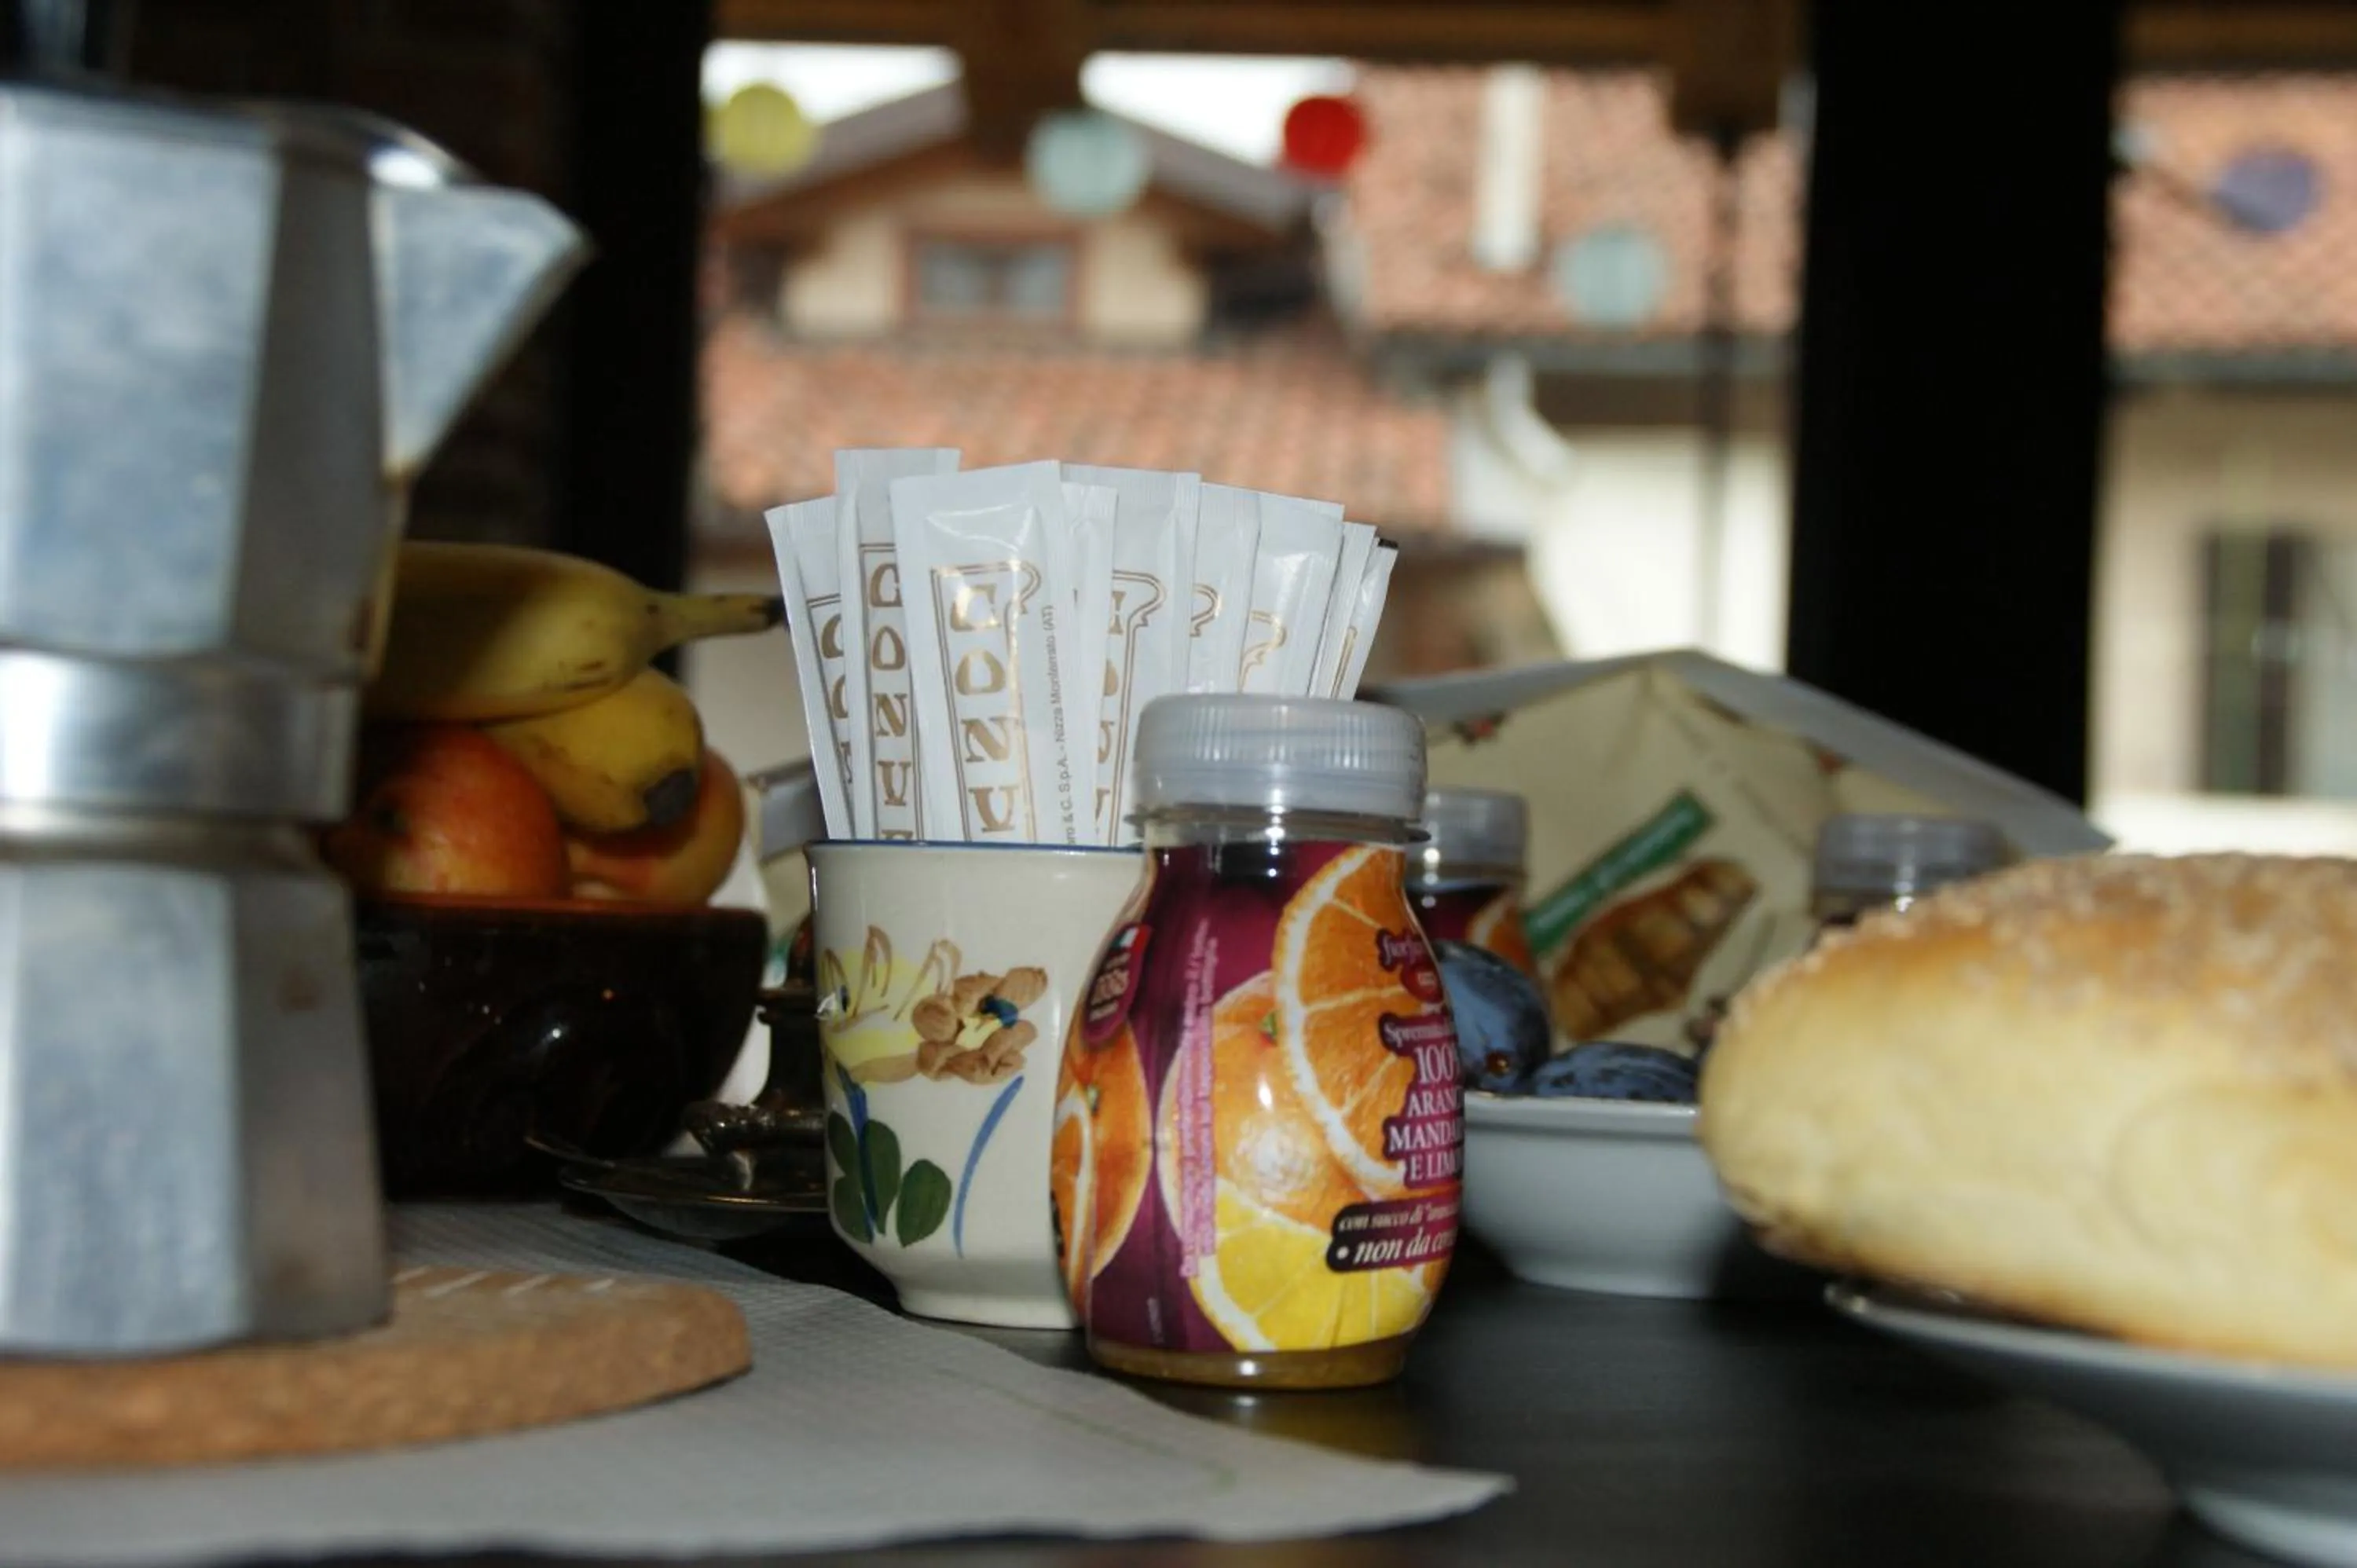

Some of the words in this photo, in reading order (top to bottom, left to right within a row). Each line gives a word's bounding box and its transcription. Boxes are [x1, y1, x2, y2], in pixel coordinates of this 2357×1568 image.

[1040, 604, 1055, 631] (AT)
[1046, 636, 1061, 704] Monferrato
[1052, 707, 1066, 742] Nizza
[1409, 1155, 1423, 1181] E
[1353, 1238, 1404, 1265] non
[1405, 1226, 1431, 1258] da
